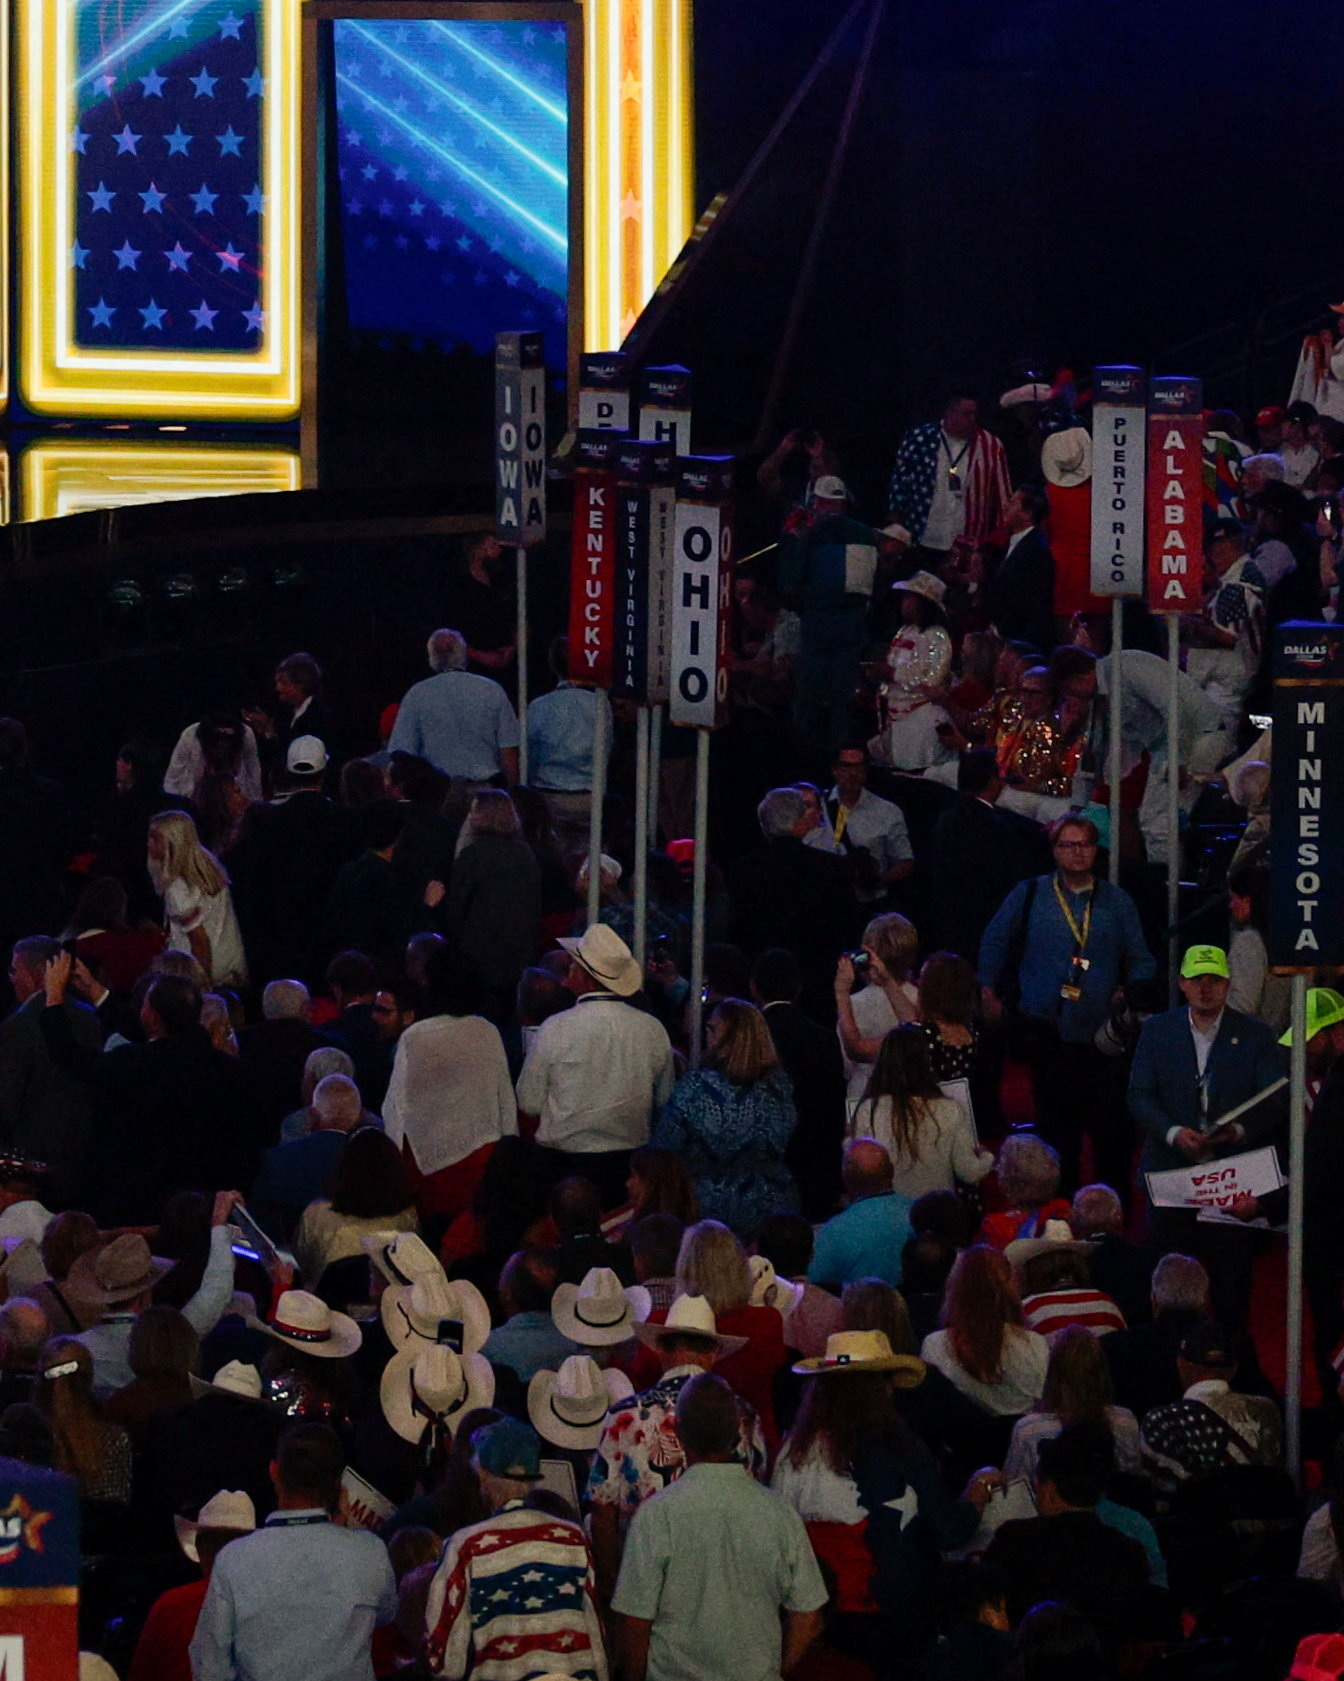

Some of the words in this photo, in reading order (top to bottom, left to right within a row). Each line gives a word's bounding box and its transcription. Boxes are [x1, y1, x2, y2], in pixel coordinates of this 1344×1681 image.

[500, 385, 518, 528] IOWA
[525, 386, 543, 526] IOWA
[1112, 417, 1127, 511] PUERTO
[1162, 430, 1187, 599] ALABAMA
[584, 487, 606, 669] KENTUCKY
[626, 499, 638, 559] WEST
[1111, 522, 1125, 583] RICO
[624, 568, 636, 688] VIRGINIA
[679, 526, 712, 703] OHIO
[716, 525, 732, 704] OHIO
[1294, 702, 1325, 951] MINNESOTA
[1190, 1167, 1237, 1187] USA
